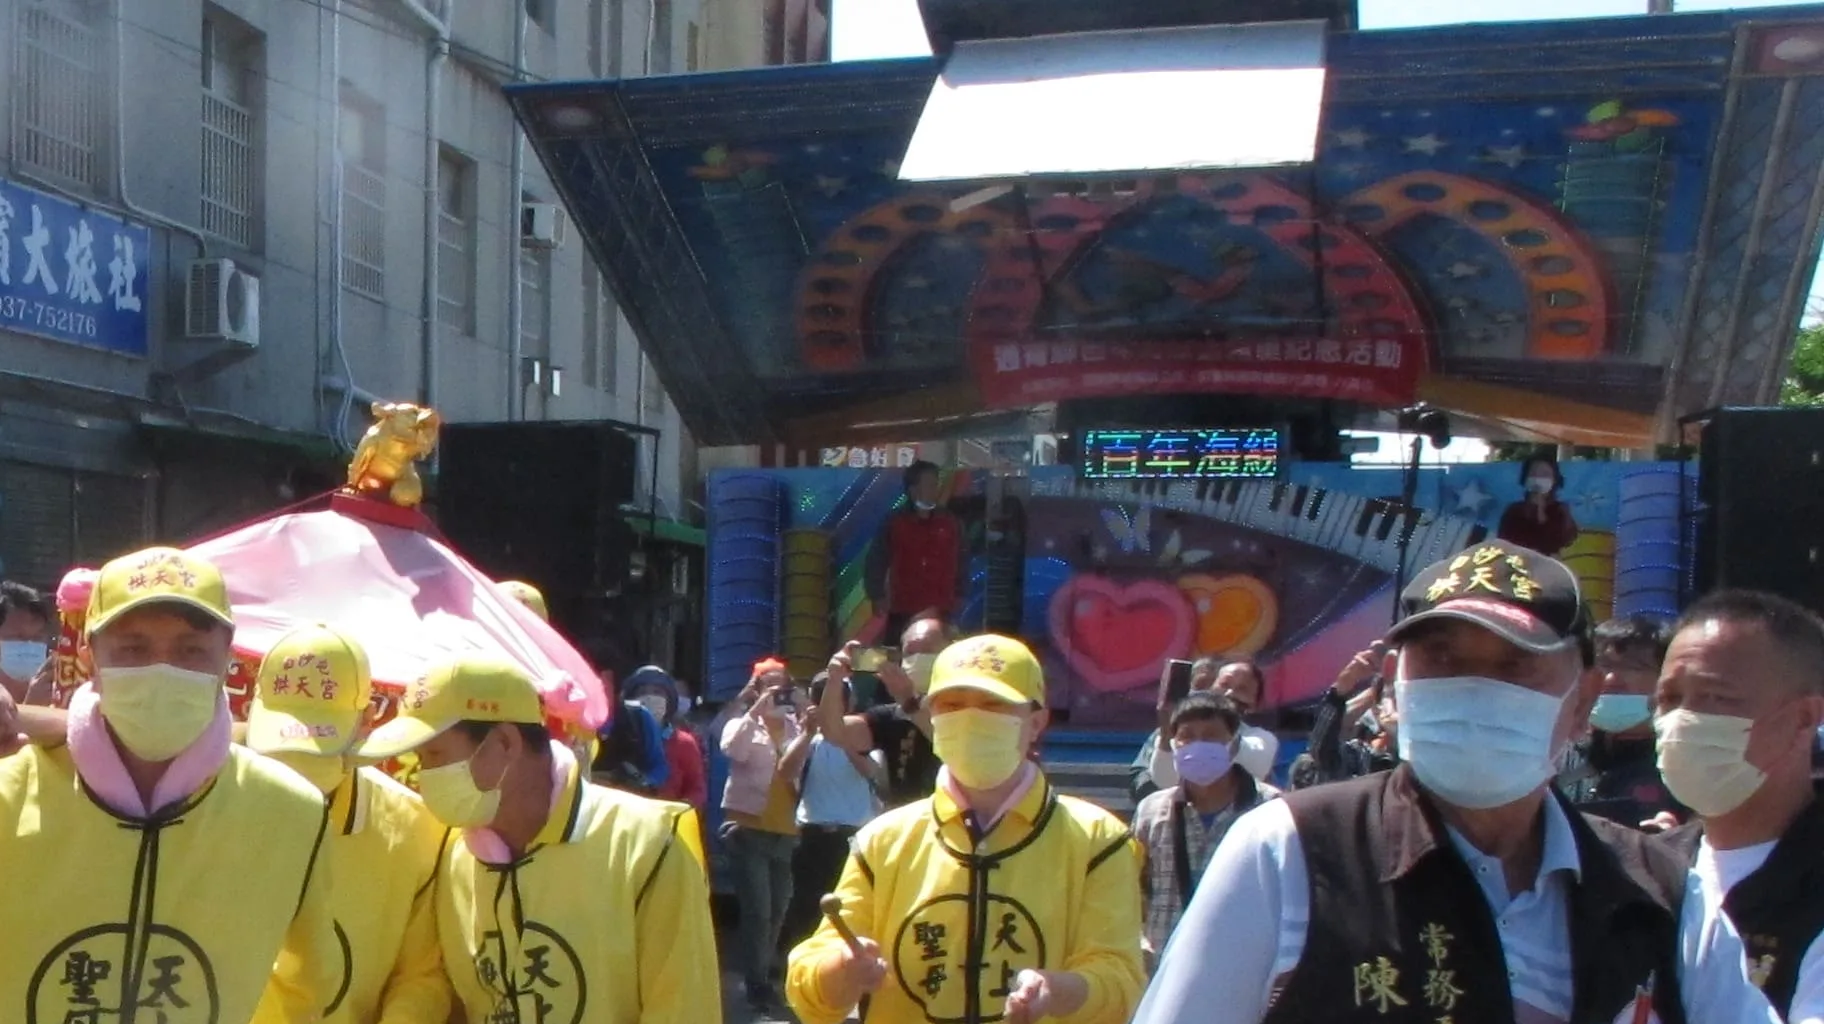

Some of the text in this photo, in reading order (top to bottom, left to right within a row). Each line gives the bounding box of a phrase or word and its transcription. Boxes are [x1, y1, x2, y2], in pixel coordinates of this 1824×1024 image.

[283, 654, 330, 676] 白沙屯
[272, 675, 338, 700] 拱天宮
